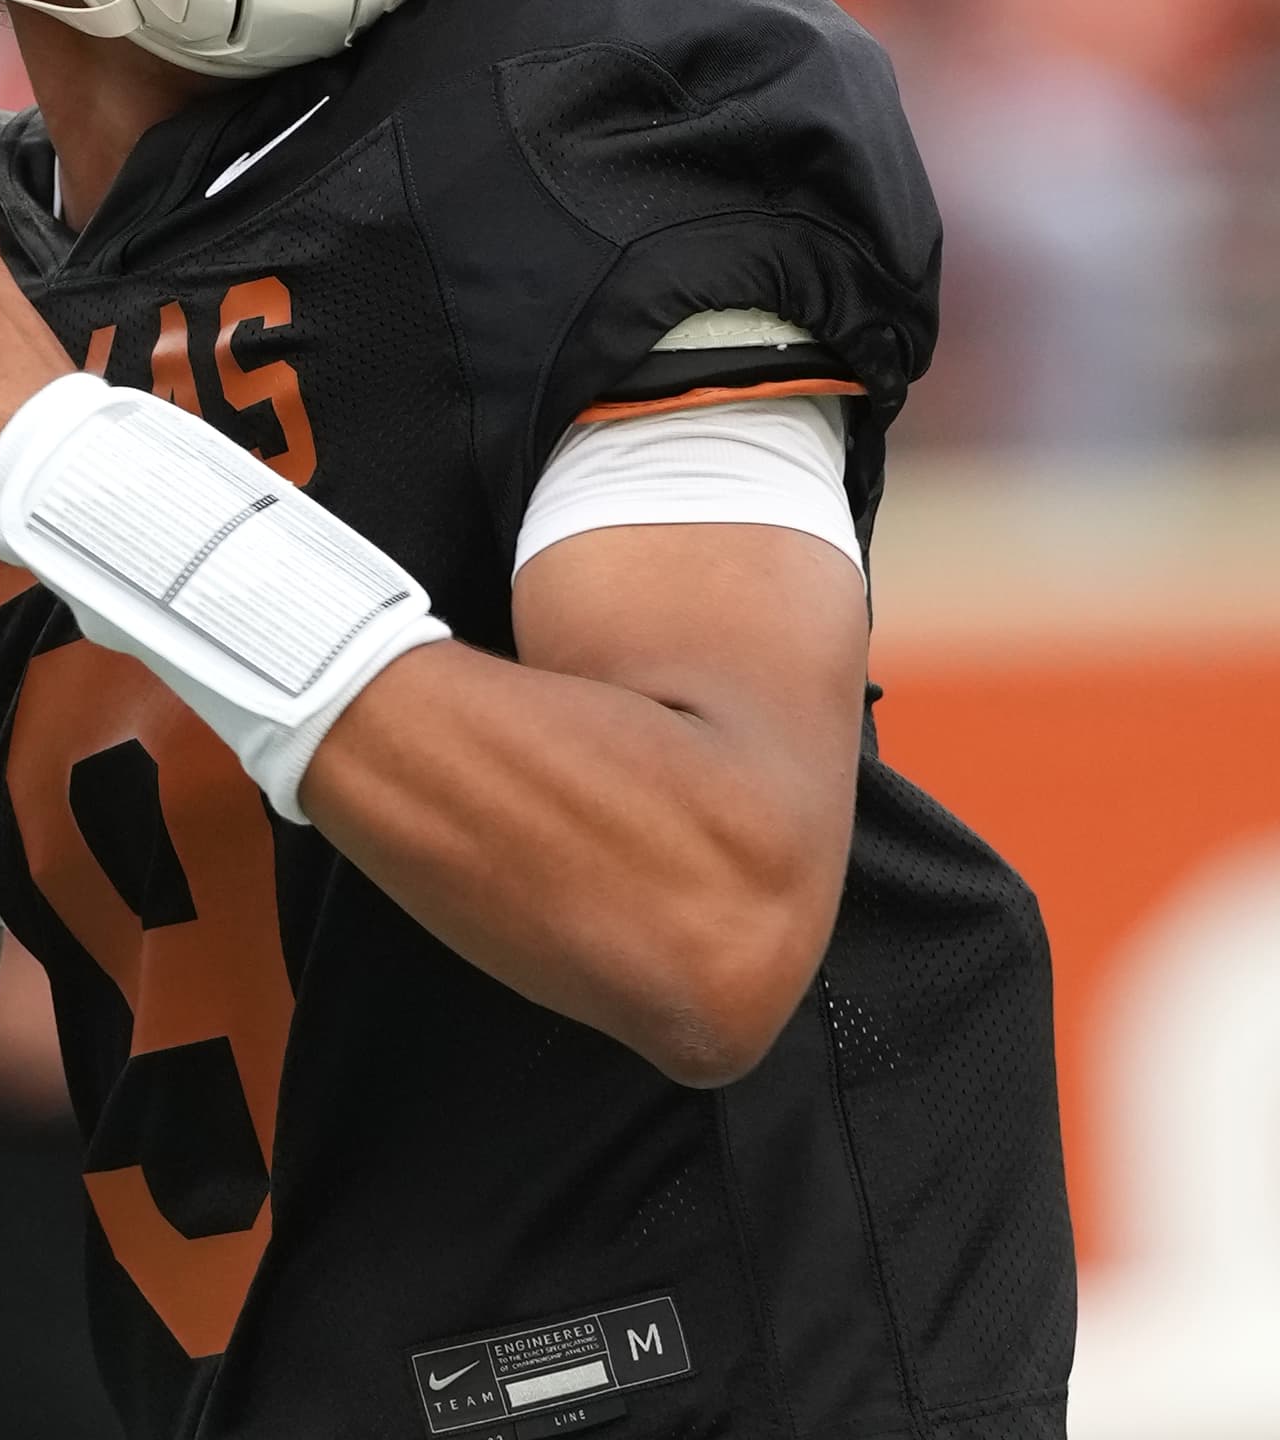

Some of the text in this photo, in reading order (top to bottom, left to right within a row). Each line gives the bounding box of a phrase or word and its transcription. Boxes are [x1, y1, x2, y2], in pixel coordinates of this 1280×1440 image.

[6, 638, 297, 1359] 9
[494, 1323, 595, 1357] ENGINEERED
[626, 1323, 664, 1362] M
[433, 1391, 495, 1414] TEAM
[554, 1409, 587, 1427] LINE
